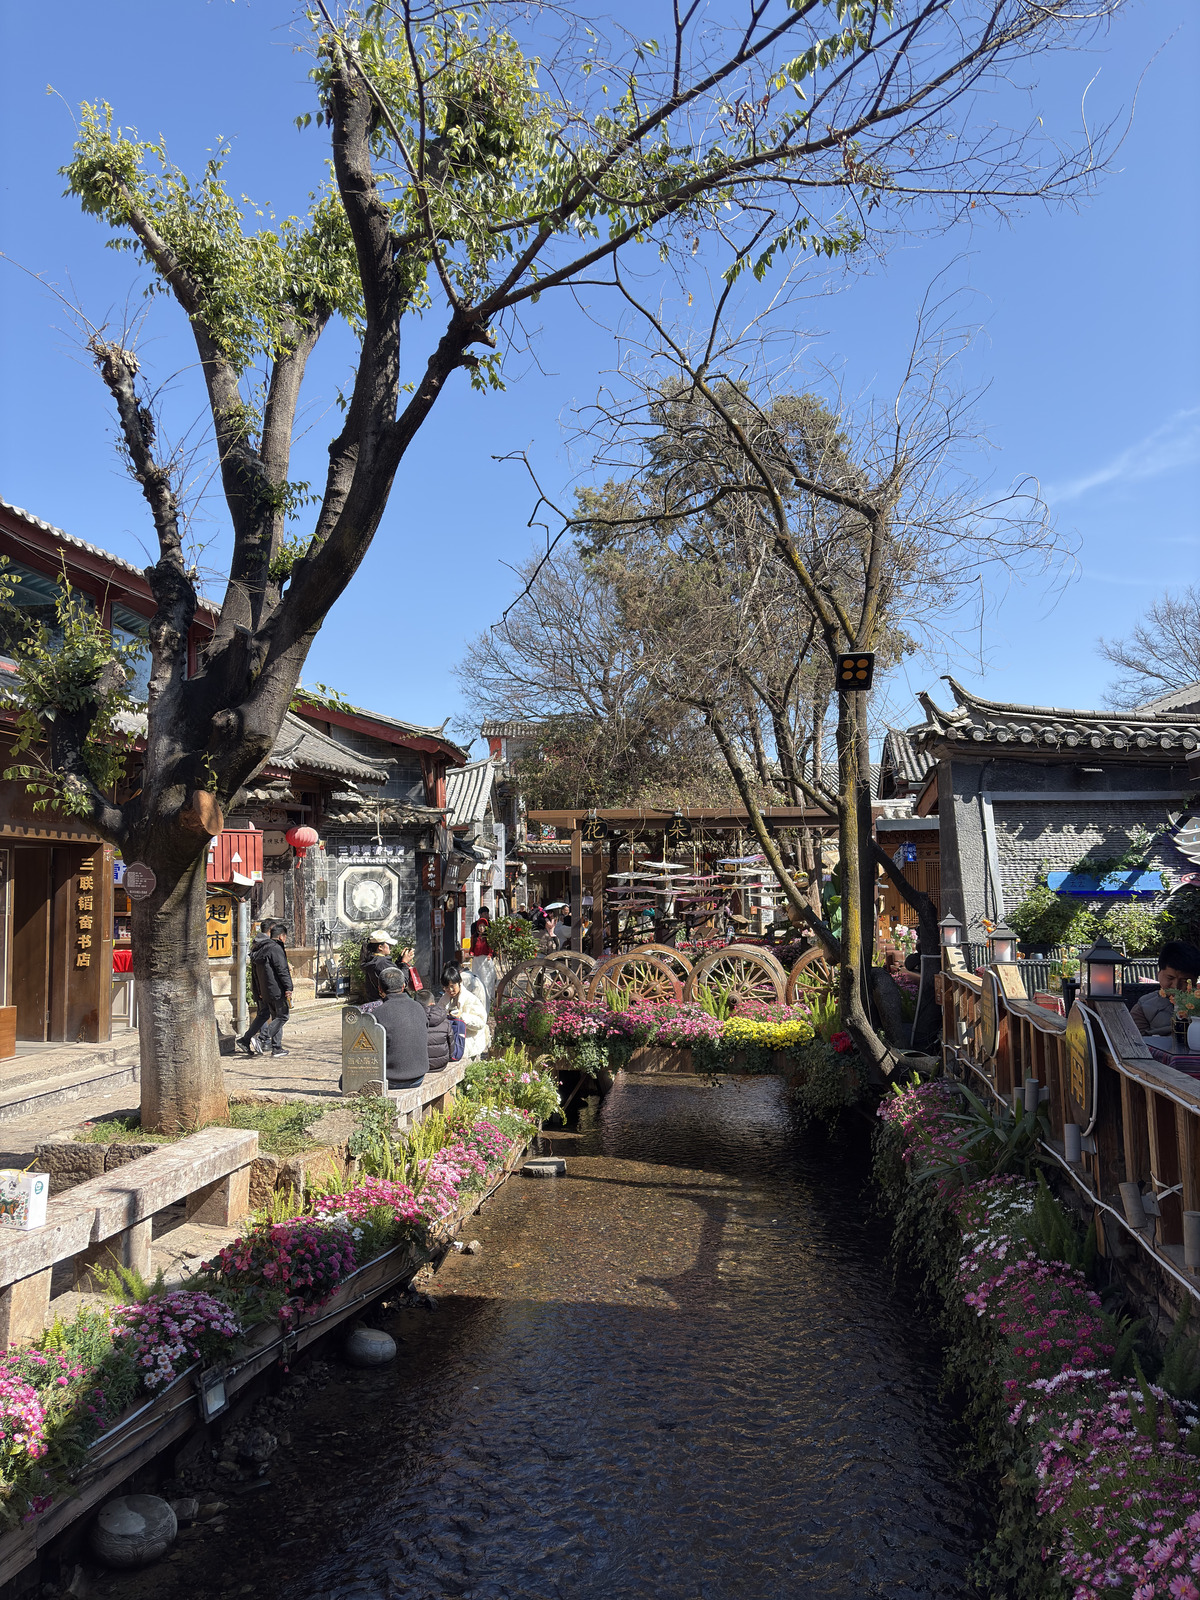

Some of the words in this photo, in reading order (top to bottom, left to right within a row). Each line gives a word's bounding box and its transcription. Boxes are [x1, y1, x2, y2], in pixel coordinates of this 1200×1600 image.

[584, 819, 605, 840] 花
[668, 819, 689, 840] 朵
[76, 857, 95, 967] 三联韬奋书店
[206, 903, 228, 951] 超市
